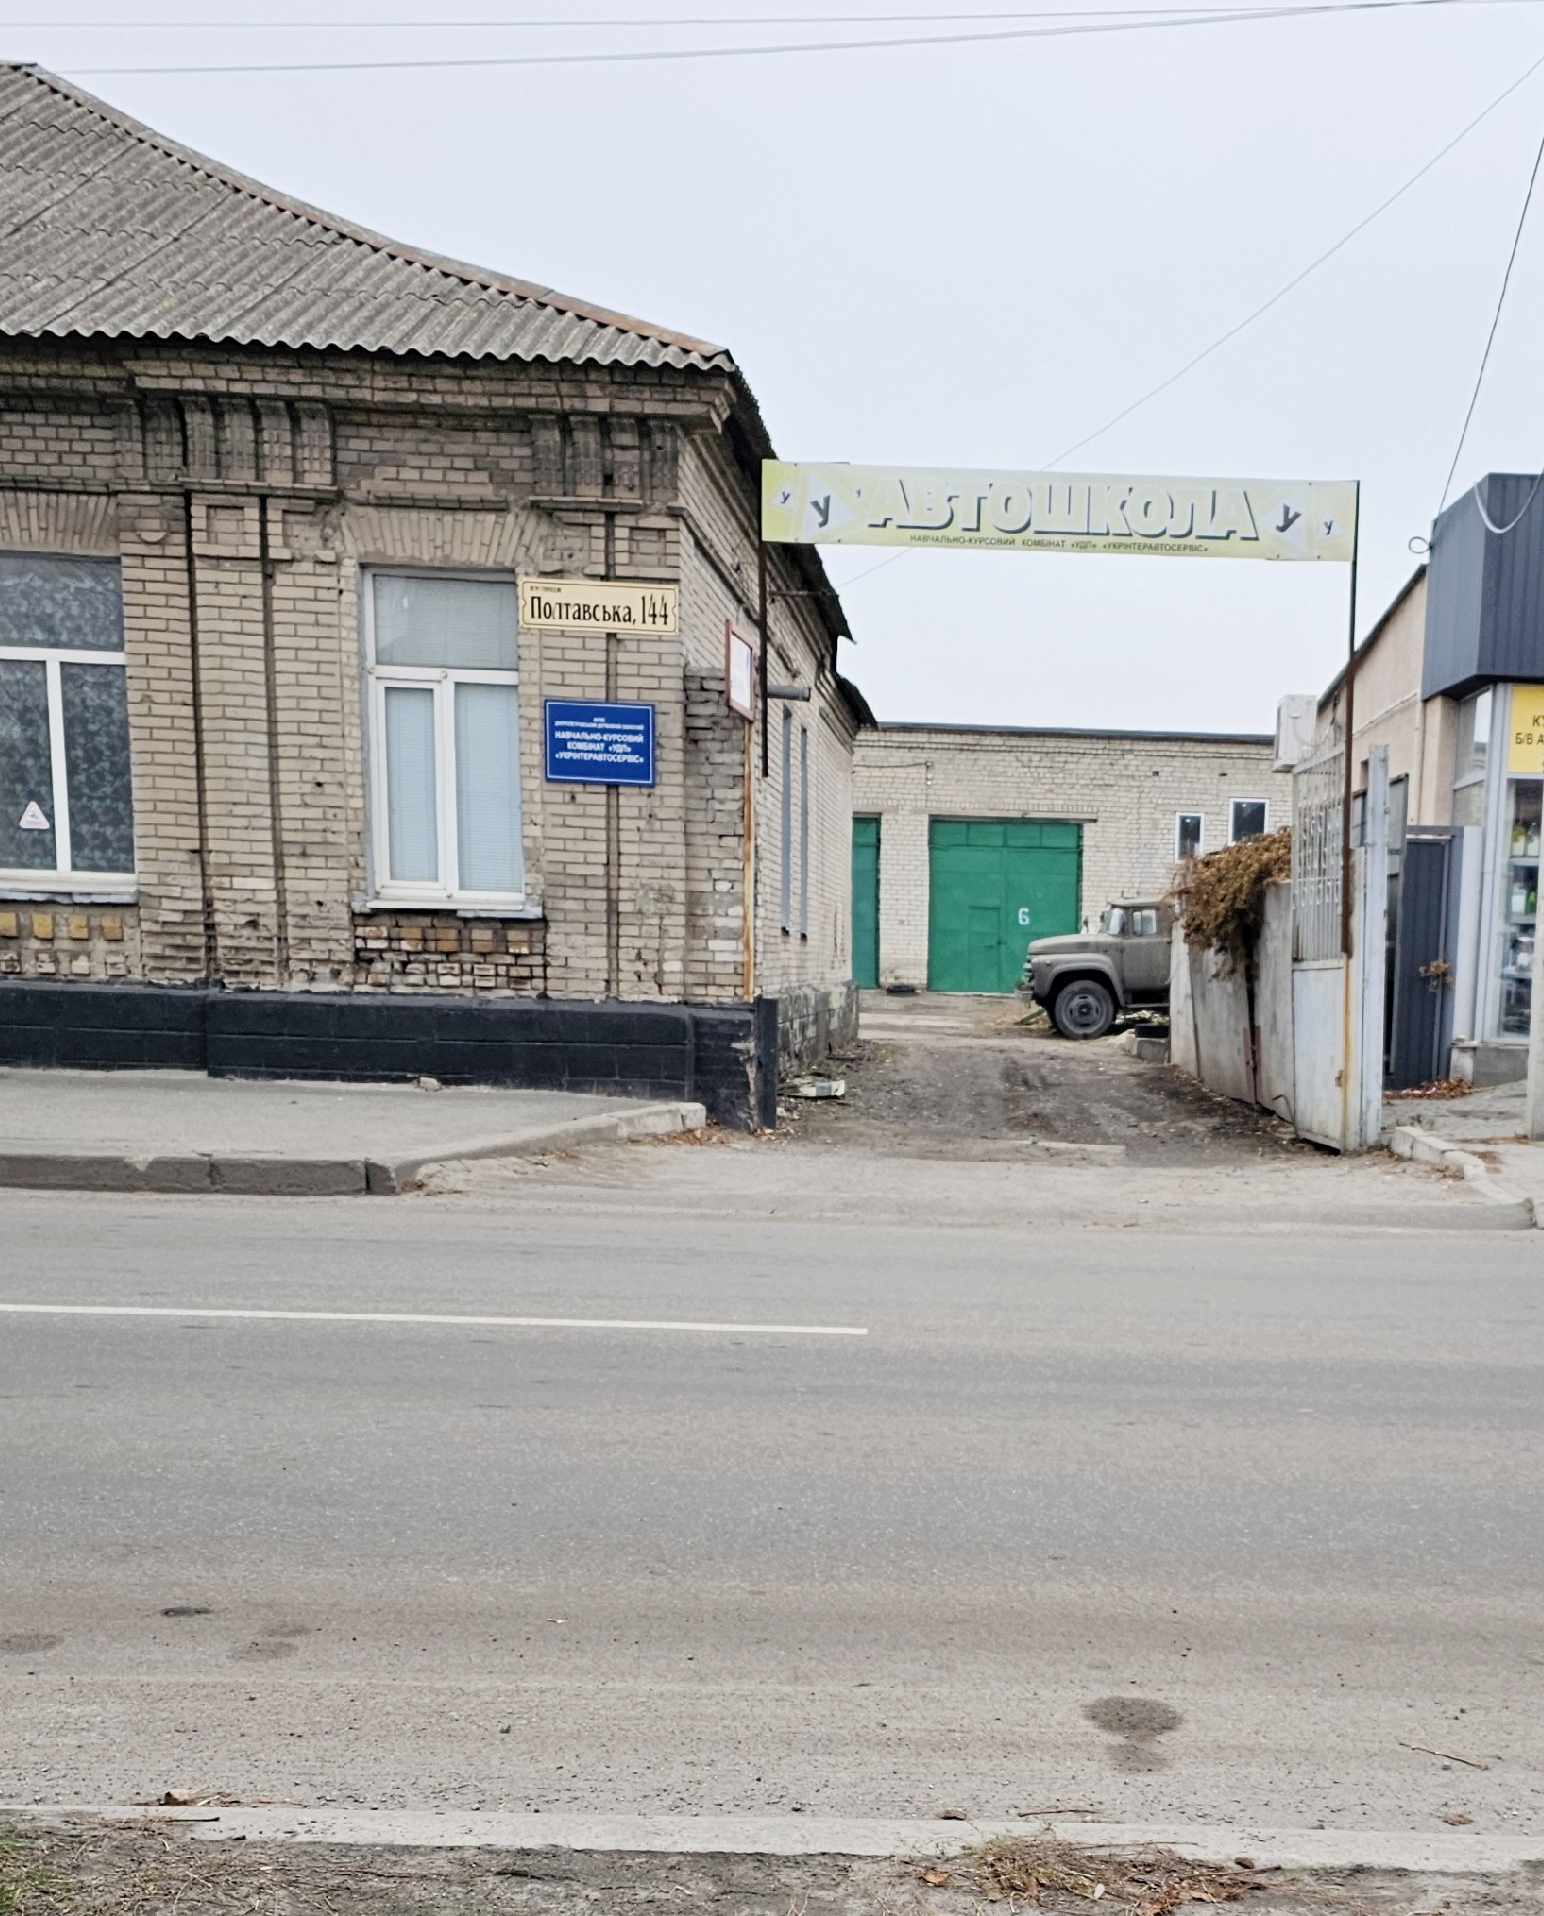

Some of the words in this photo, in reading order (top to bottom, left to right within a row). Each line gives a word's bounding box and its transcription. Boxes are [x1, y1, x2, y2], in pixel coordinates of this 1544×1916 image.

[867, 476, 1260, 542] АВТОШКОЛА
[910, 535, 1016, 546] НАВЧАЛЬНО-КУРСОВИЙ
[1022, 538, 1066, 548] КОМБІНАТ
[530, 596, 637, 626] Полтавська,
[641, 592, 668, 626] 144
[554, 731, 644, 743] НАВЧАЛЬНО-КУРСОВИЙ
[1018, 907, 1030, 925] 6
